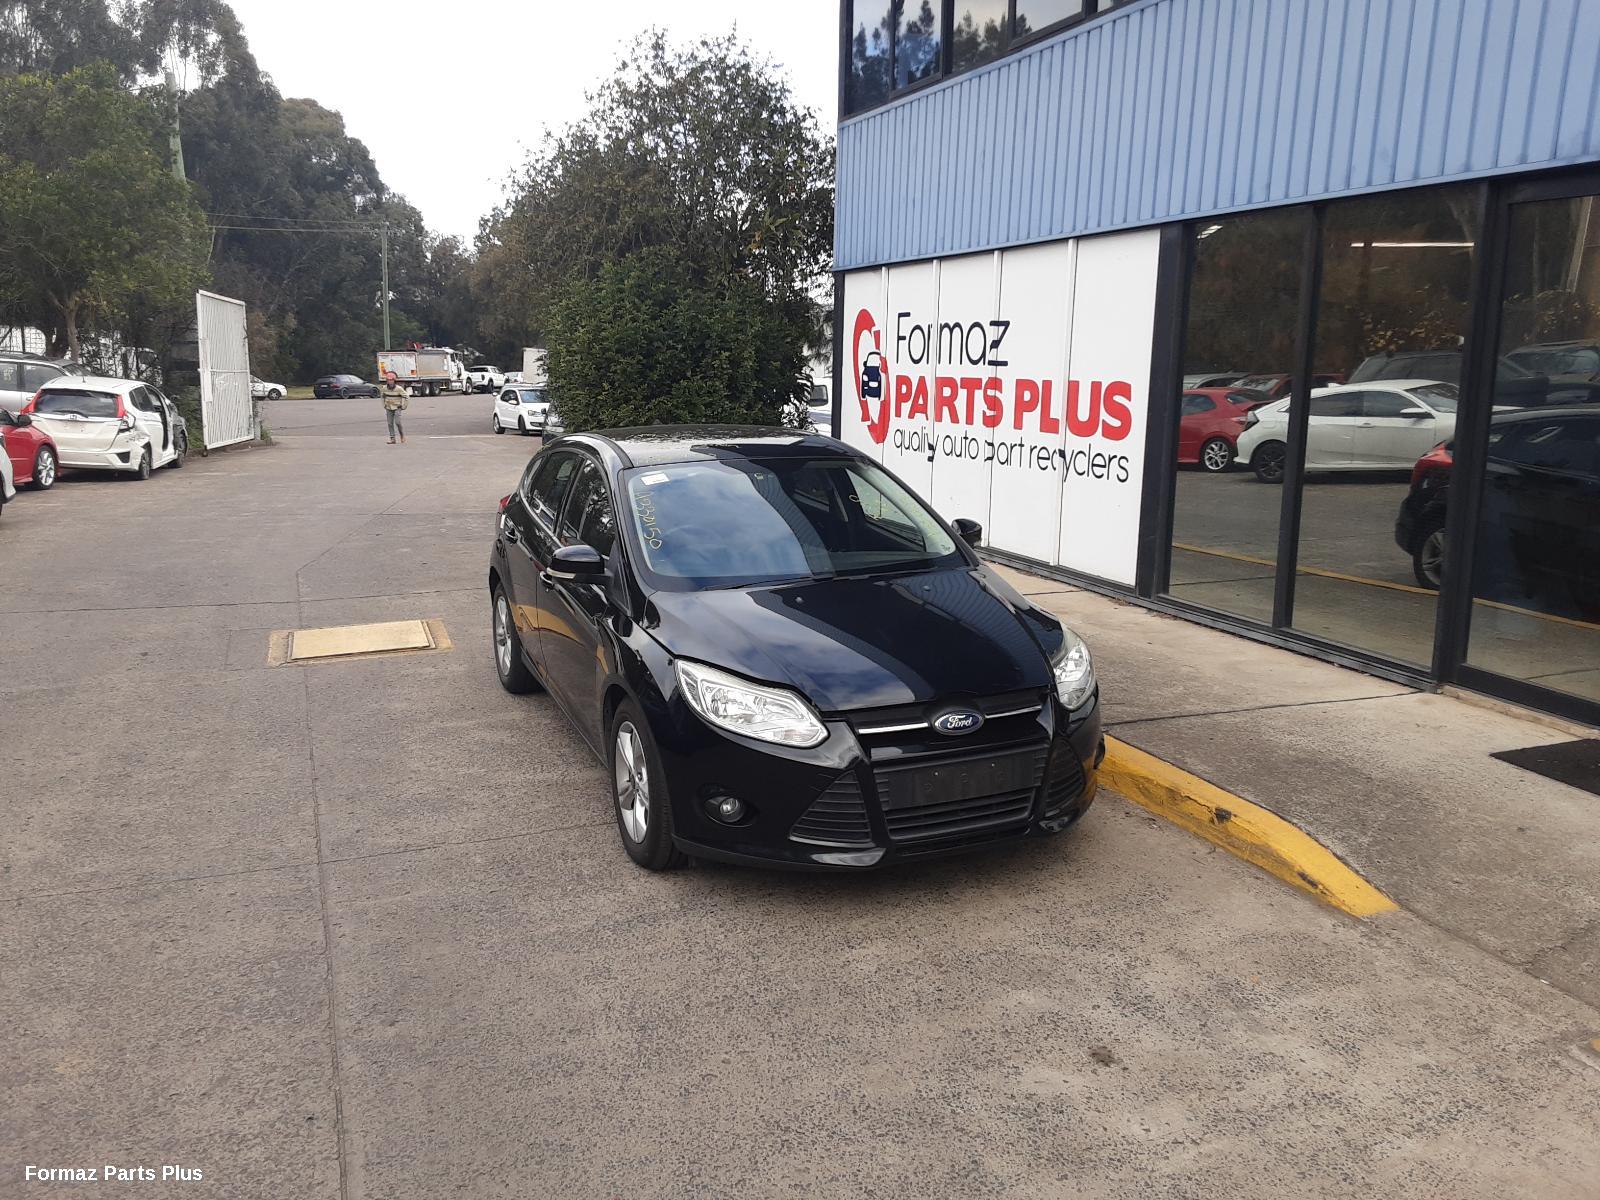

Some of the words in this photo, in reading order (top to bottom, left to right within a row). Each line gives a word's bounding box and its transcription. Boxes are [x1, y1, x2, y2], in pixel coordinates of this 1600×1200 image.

[896, 312, 1010, 366] Formaz
[895, 375, 1003, 428] PARTS
[1013, 379, 1132, 440] PLUS
[894, 426, 939, 462] qualiy
[943, 430, 979, 460] auto
[1029, 443, 1129, 483] recyclers
[947, 714, 972, 729] Ford
